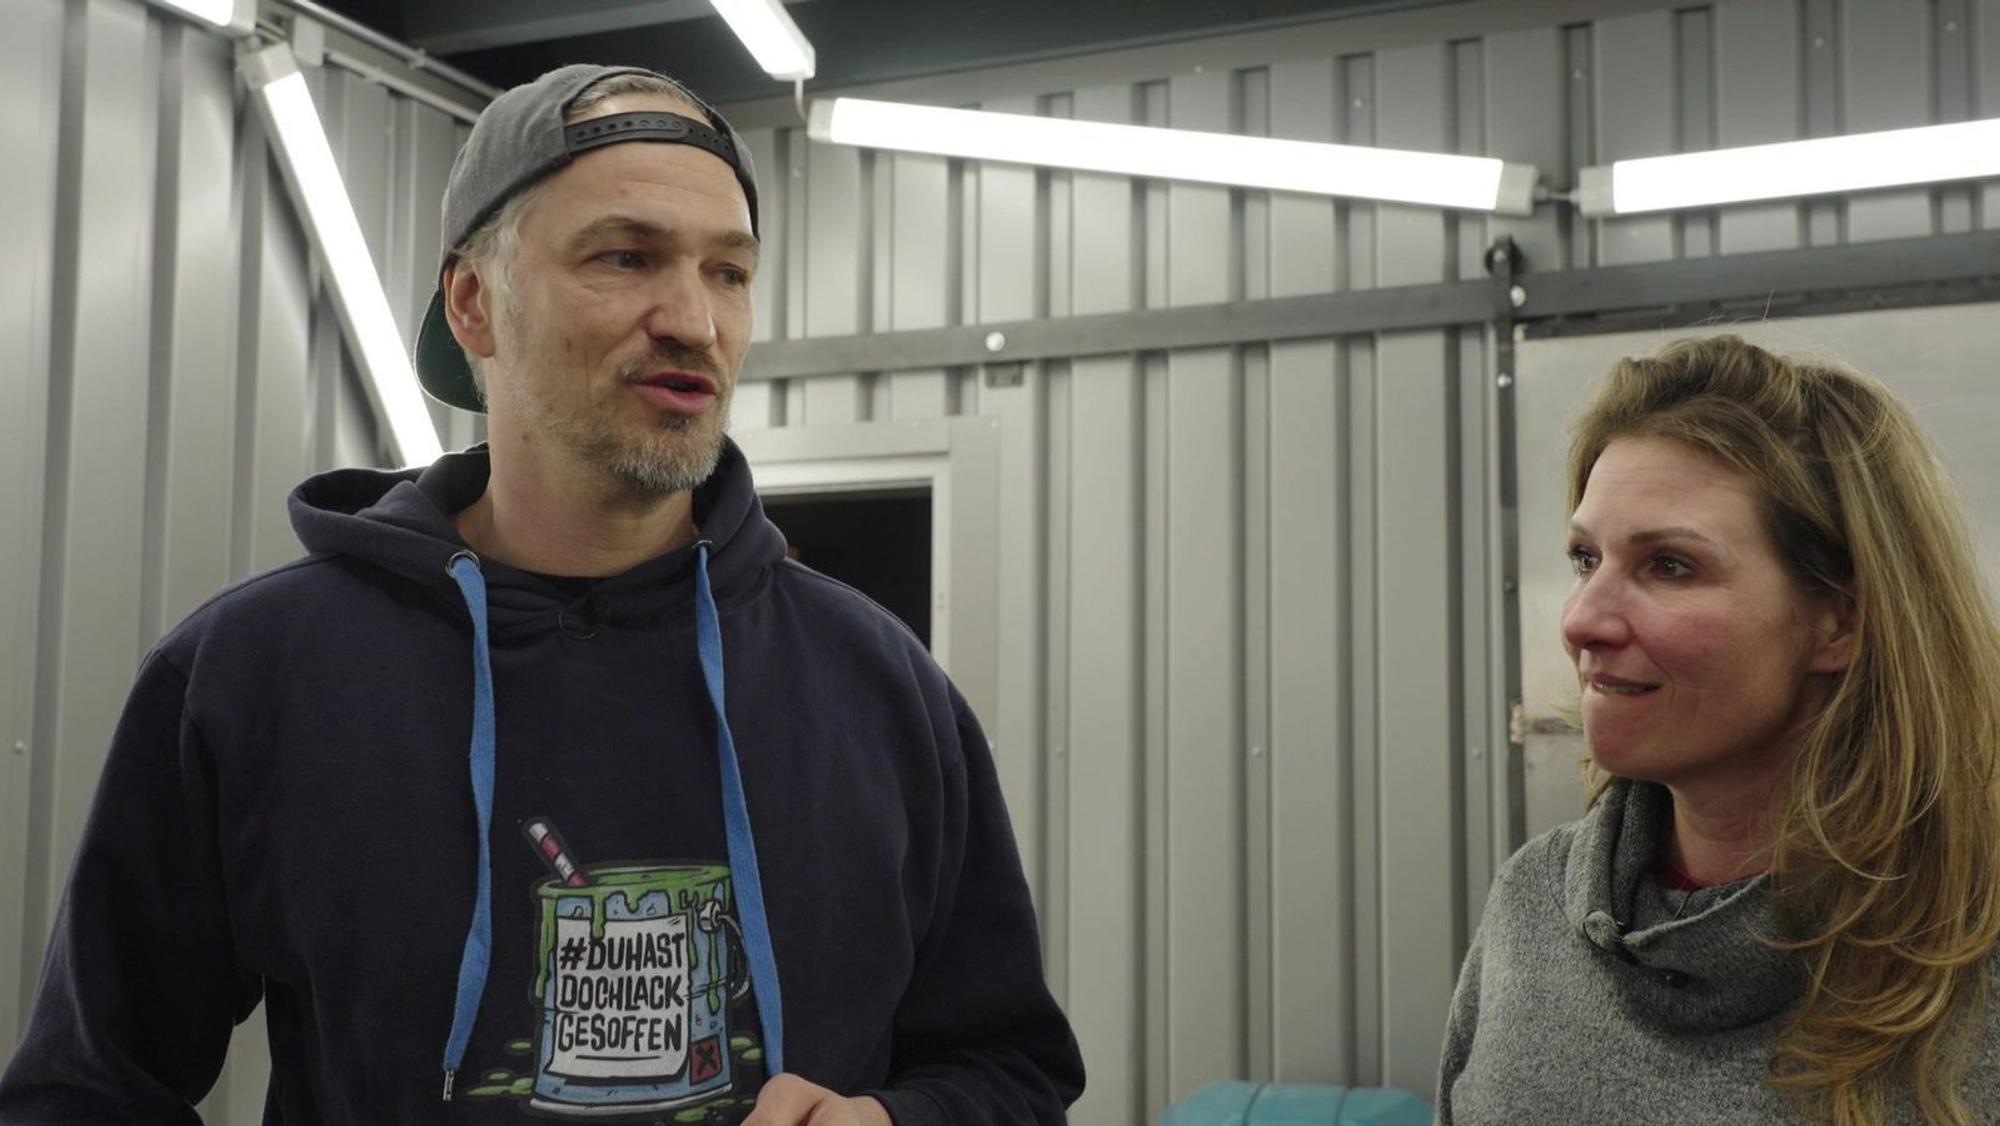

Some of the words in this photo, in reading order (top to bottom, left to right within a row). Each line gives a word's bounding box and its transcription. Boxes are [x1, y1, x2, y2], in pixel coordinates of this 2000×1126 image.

[559, 933, 685, 971] #DUHAST
[561, 975, 684, 1010] DOCHLACK
[558, 1014, 682, 1051] GESOFFEN
